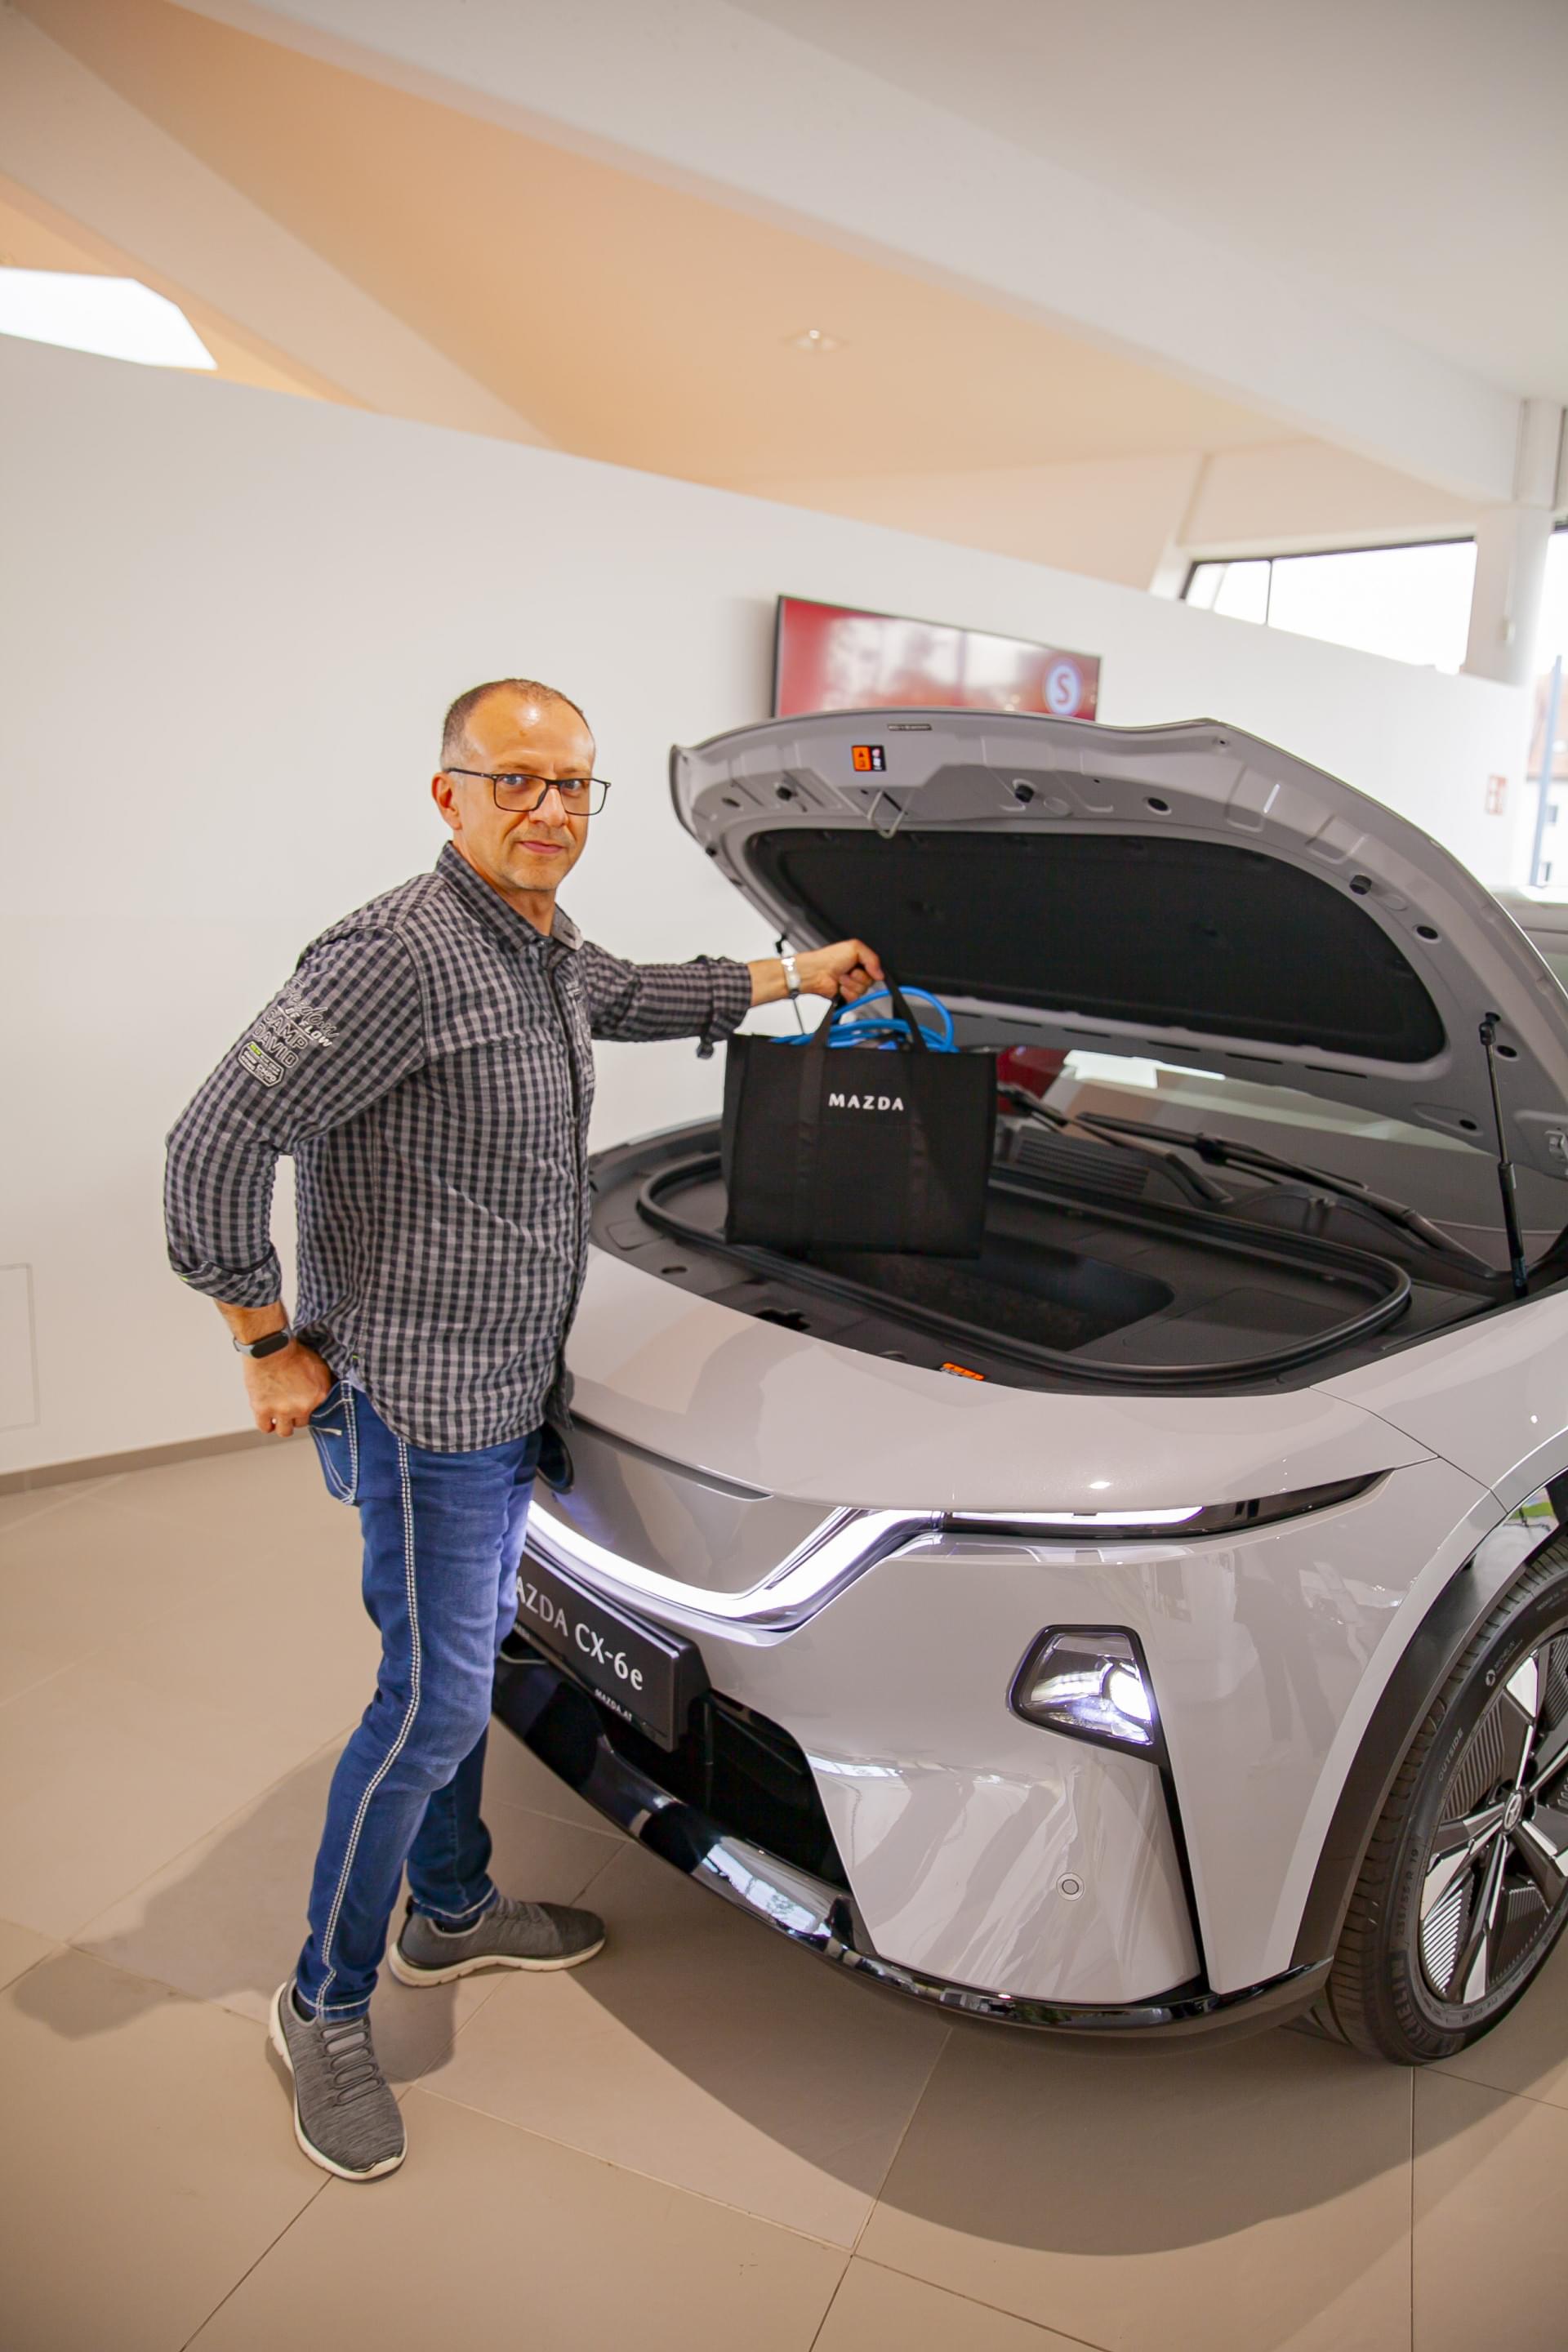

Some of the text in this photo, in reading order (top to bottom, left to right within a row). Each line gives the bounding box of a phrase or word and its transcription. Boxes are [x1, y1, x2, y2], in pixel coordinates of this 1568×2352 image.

[1055, 672, 1072, 706] S
[252, 1022, 300, 1068] DAVID
[263, 1009, 309, 1050] CAMP
[284, 1007, 333, 1048] OF FLOW
[828, 1093, 904, 1111] MAZDA
[515, 1575, 644, 1690] AZDA CX-6e
[1438, 1727, 1464, 1782] OUTSIDE
[1410, 1848, 1419, 1864] 19
